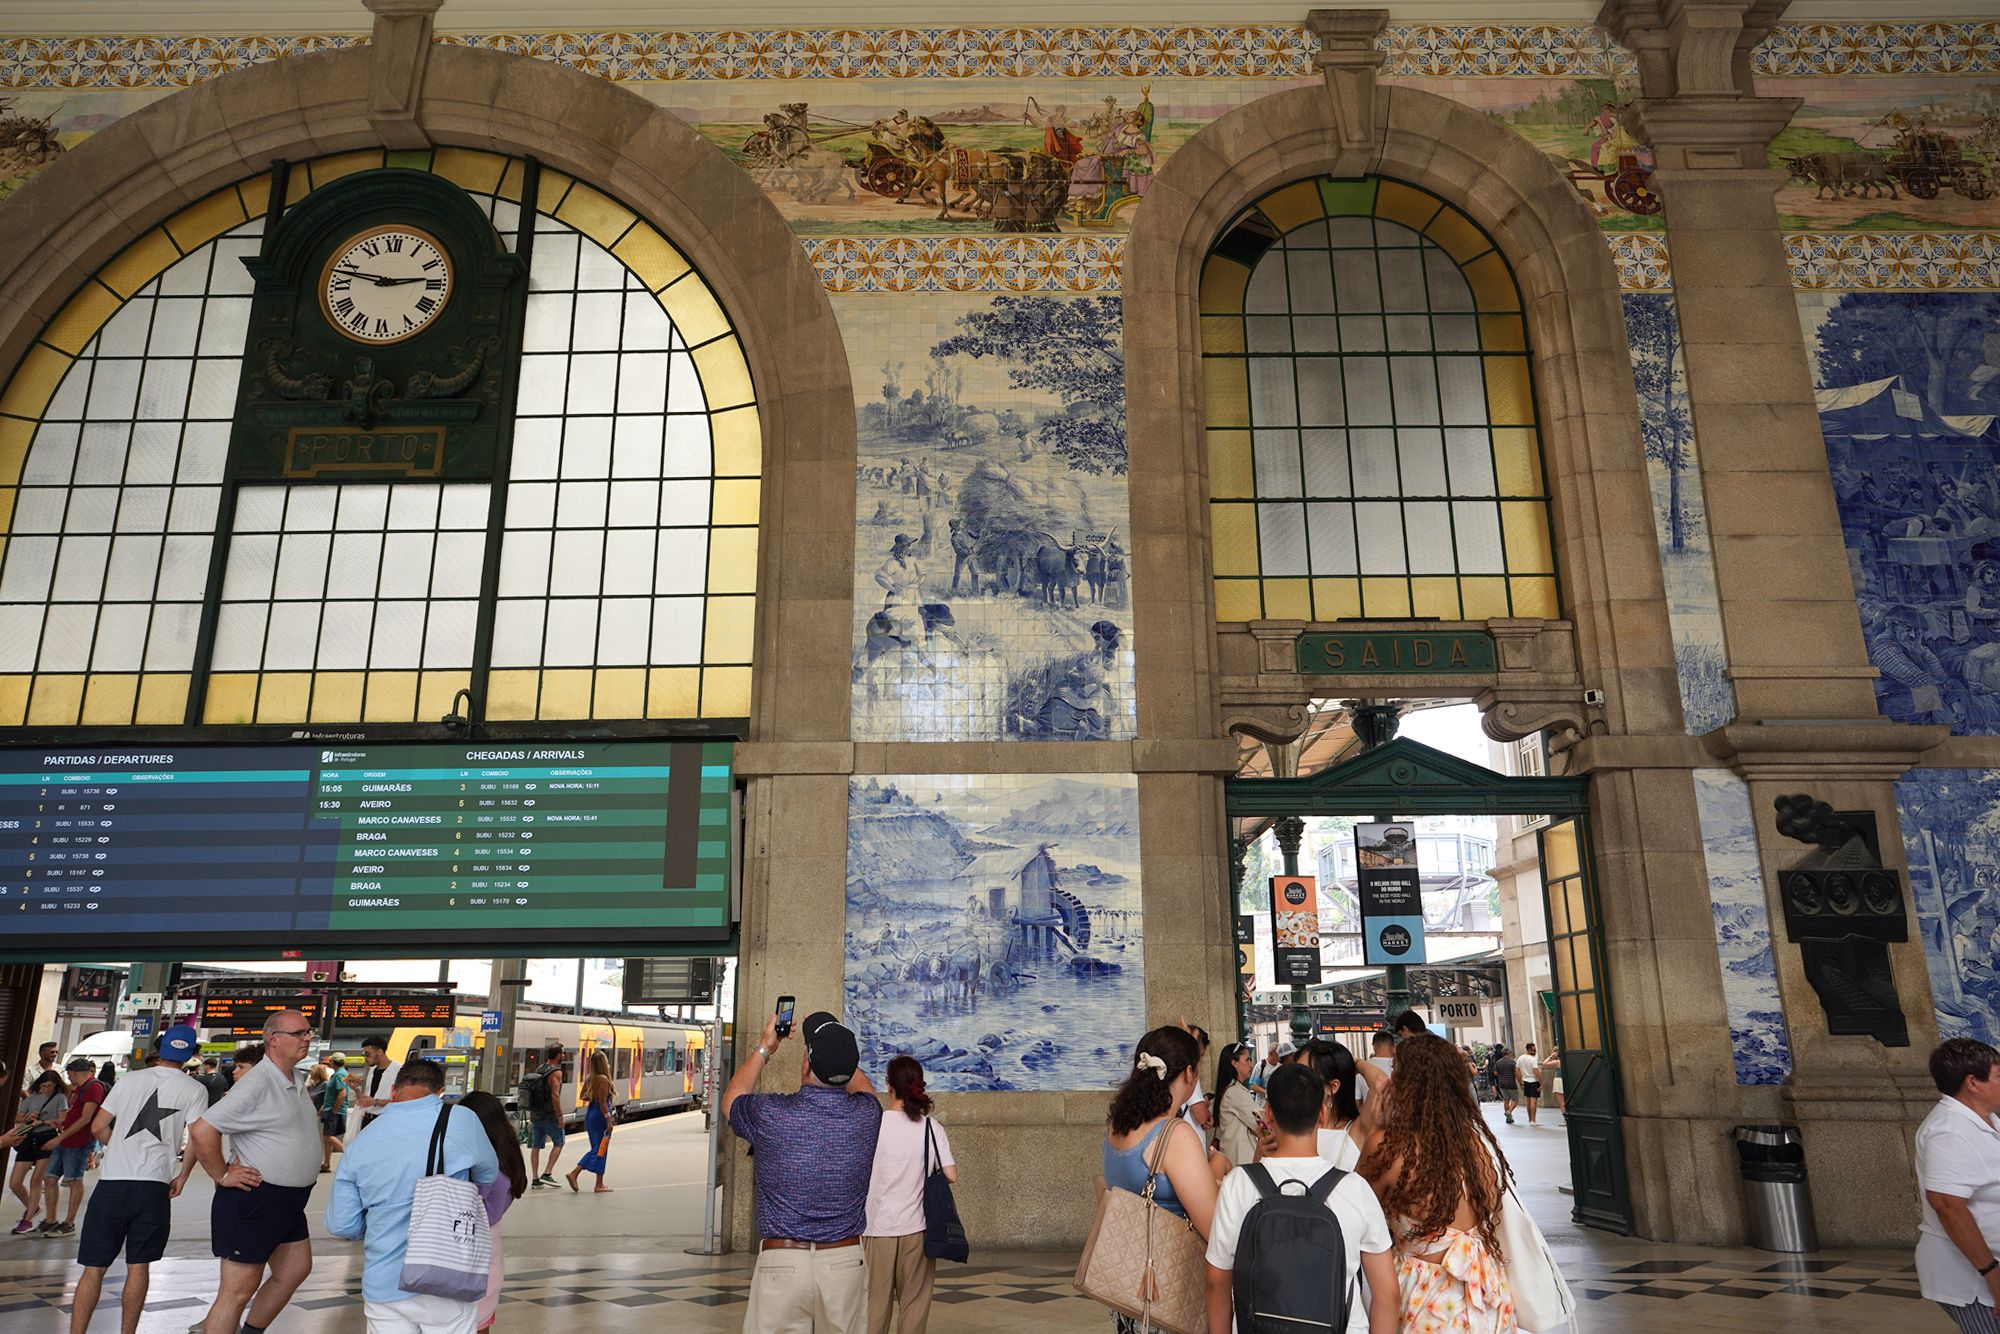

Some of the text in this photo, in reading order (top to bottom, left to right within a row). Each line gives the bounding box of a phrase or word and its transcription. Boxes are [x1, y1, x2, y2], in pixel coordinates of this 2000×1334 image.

[312, 434, 419, 461] PORTO
[1324, 639, 1468, 667] SAIDA
[466, 751, 525, 760] CHEGADAS
[533, 750, 585, 760] ARRIVALS
[44, 756, 95, 765] PARTIDAS
[103, 755, 174, 764] DEPARTURES
[40, 788, 47, 796] 2
[321, 784, 343, 792] 15:05
[362, 783, 412, 792] GUIMARÃES
[319, 800, 341, 809] 15:30
[360, 800, 392, 808] AVEIRO
[358, 816, 390, 824] MARCO
[391, 815, 442, 824] CANAVESES
[356, 833, 387, 841] BRAGA
[354, 849, 386, 857] MARCO
[387, 848, 439, 857] CANAVESES
[352, 865, 385, 873] AVEIRO
[350, 882, 382, 890] BRAGA
[348, 897, 400, 907] GUIMARÃES
[1440, 1003, 1477, 1017] PORTO
